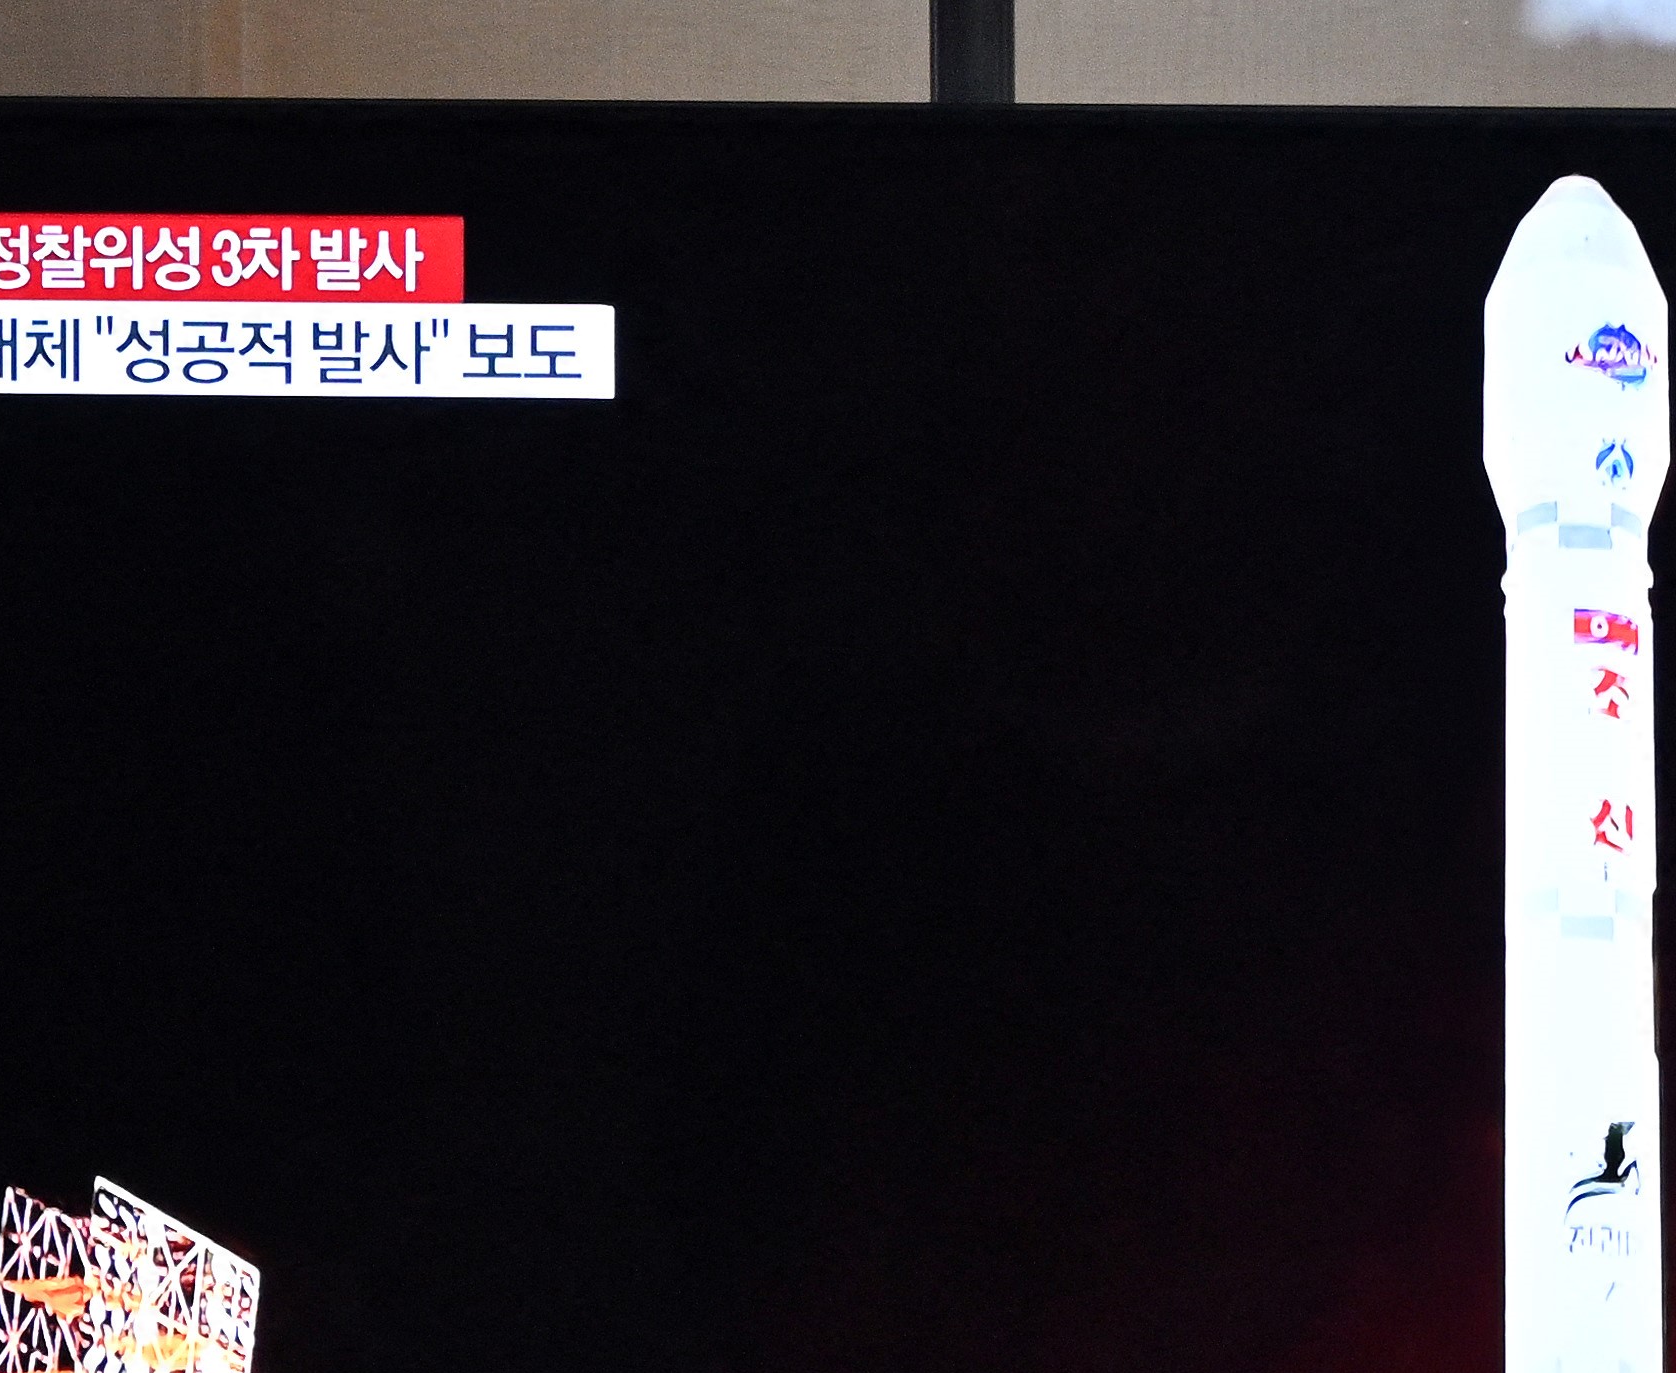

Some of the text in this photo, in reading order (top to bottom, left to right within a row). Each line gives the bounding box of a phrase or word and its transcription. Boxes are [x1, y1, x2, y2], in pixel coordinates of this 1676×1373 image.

[212, 227, 300, 290] 3차
[311, 228, 424, 291] 발사
[96, 316, 292, 384] "성공적
[312, 319, 449, 384] 발사"
[462, 323, 582, 379] 보도
